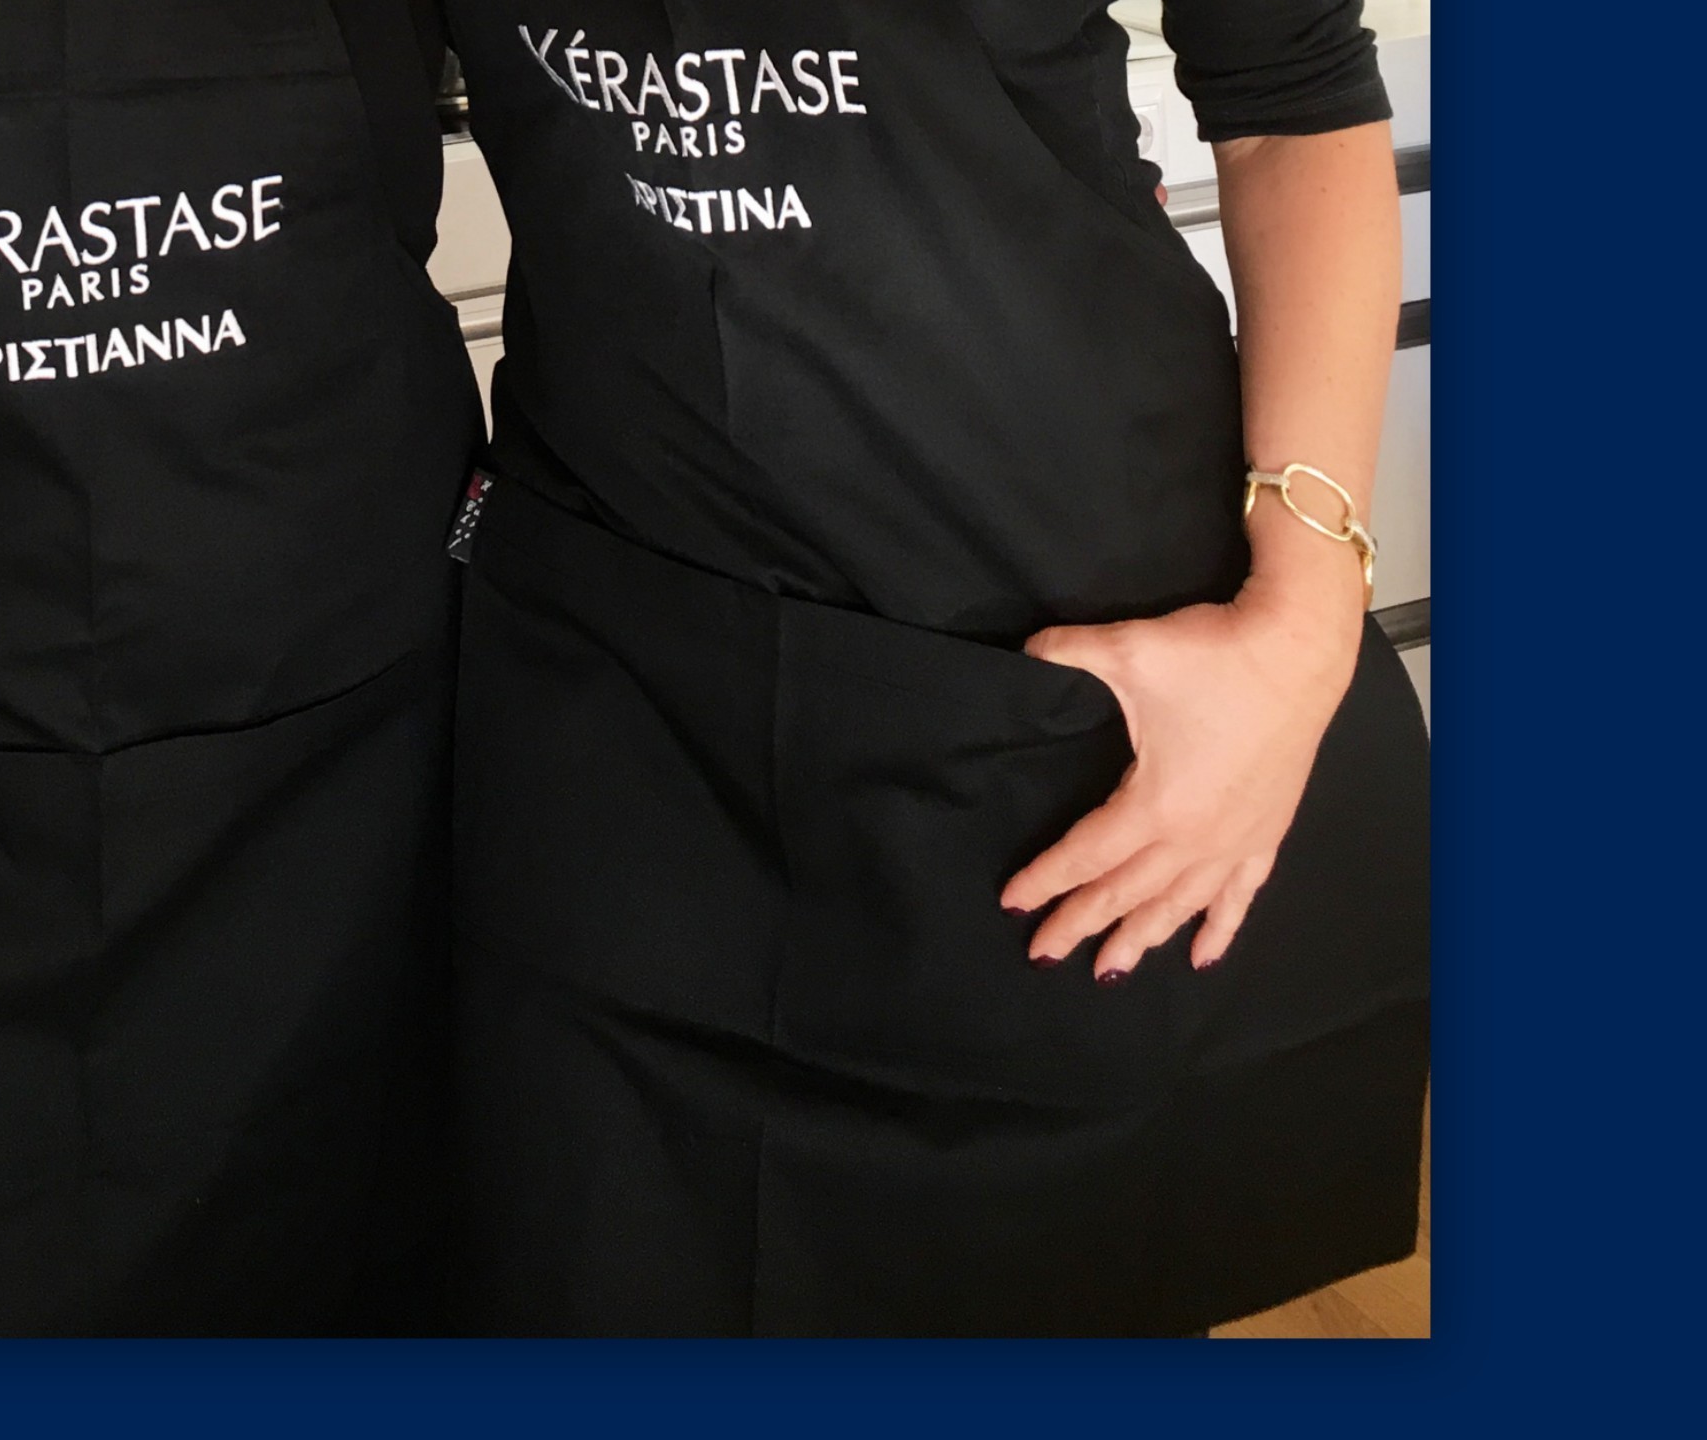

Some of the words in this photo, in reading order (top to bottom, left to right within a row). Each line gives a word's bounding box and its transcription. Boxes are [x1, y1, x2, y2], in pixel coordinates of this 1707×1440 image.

[517, 24, 868, 122] KÉRASTASE
[632, 121, 747, 158] PARIS
[21, 264, 150, 311] PARIS
